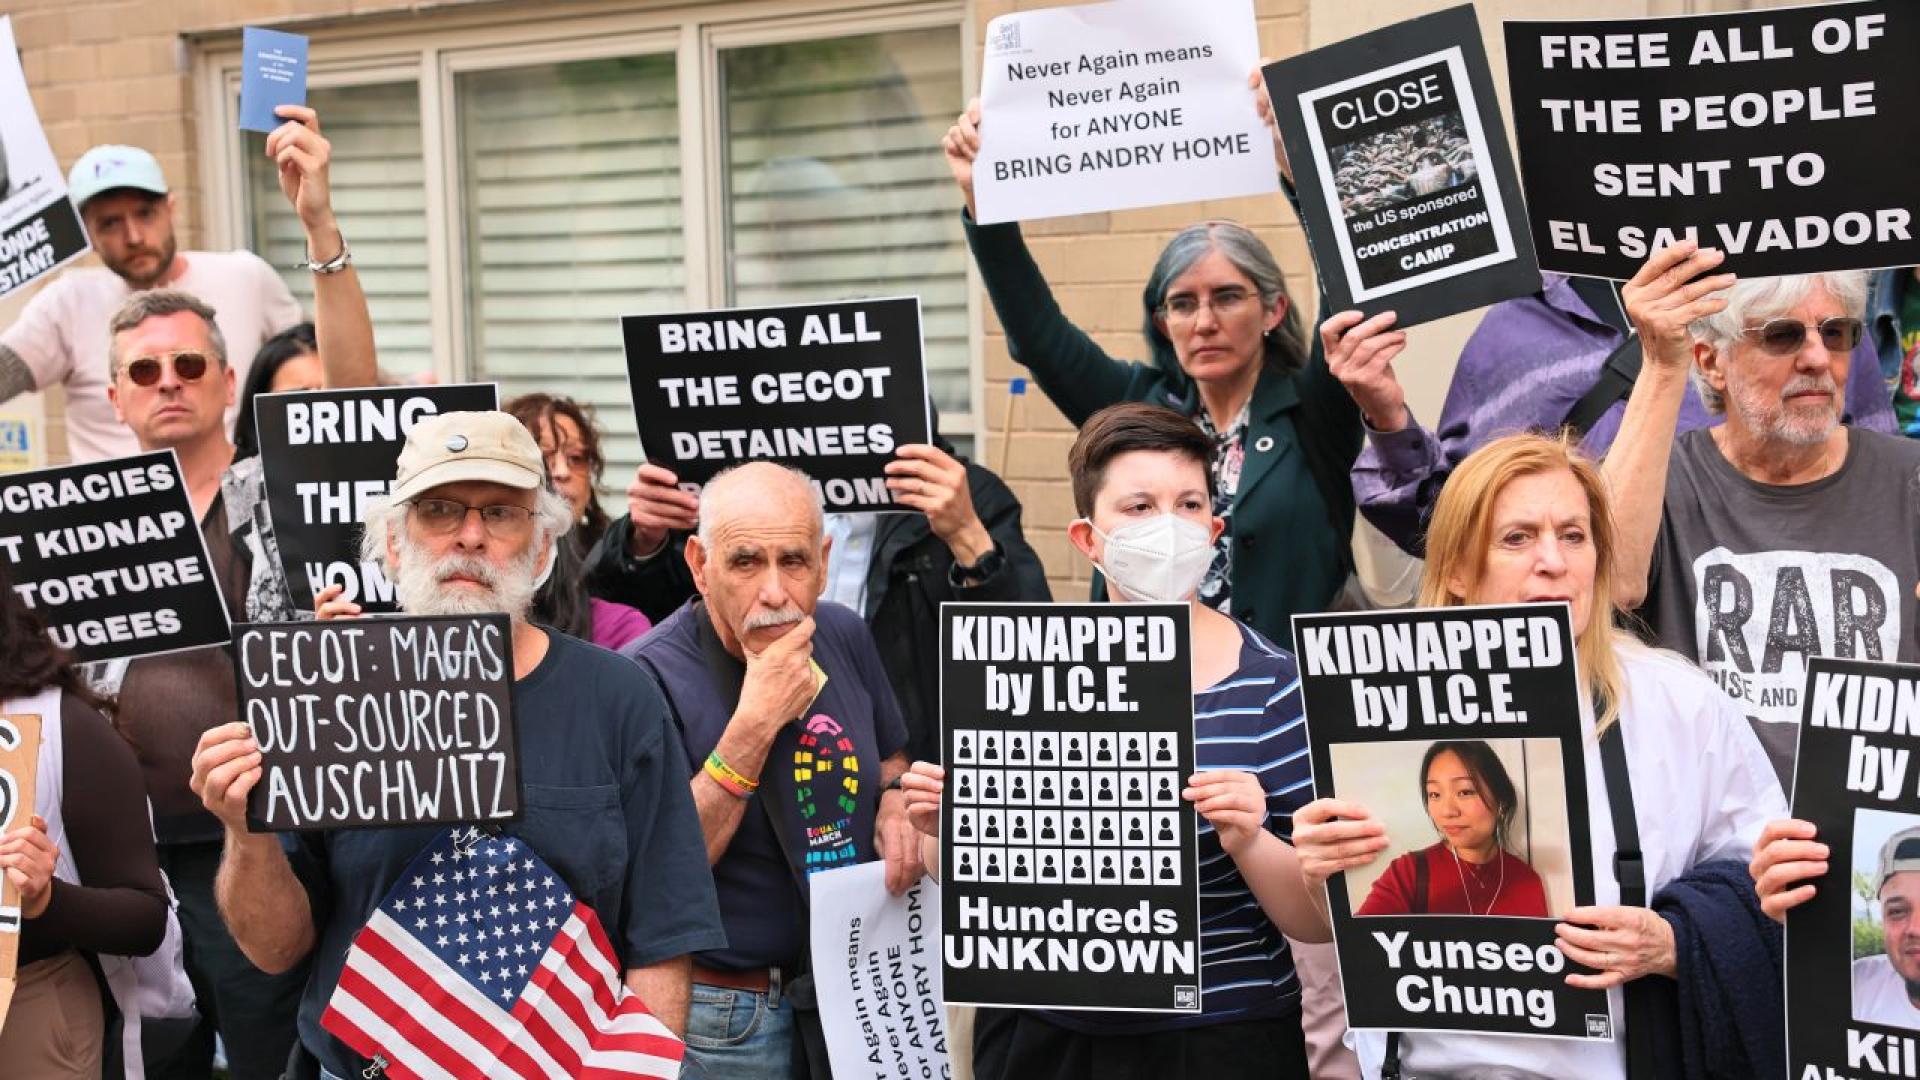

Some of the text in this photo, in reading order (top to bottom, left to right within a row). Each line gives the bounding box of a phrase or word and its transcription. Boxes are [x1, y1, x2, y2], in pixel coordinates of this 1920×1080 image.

[1007, 43, 1213, 82] Never Again means
[1539, 13, 1887, 69] FREE ALL OF
[1048, 76, 1180, 109] Never Again
[1331, 73, 1444, 130] CLOSE
[1541, 81, 1877, 134] THE PEOPLE
[1051, 107, 1184, 141] for ANYONE
[994, 133, 1251, 181] BRING ANDRY HOME
[1593, 152, 1826, 198] SENT TO
[1352, 185, 1478, 235] the US sponsored
[1355, 210, 1490, 260] CONCENTRATION
[1548, 207, 1912, 259] EL SALVADOR
[1400, 242, 1456, 272] CAMP
[659, 311, 882, 354] BRING ALL
[659, 367, 892, 408] THE CECOT
[671, 423, 895, 461] DETAINEES
[296, 480, 397, 524] THE
[809, 478, 899, 506] OM
[35, 511, 186, 559] KIDNAP
[13, 556, 204, 609] TORTURE
[305, 560, 402, 602] HOM
[47, 608, 182, 649] UGEES
[951, 614, 1177, 664] KIDNAPPED
[1703, 563, 1887, 673] RAR
[242, 629, 379, 687] CECOT:
[1301, 616, 1564, 677] KIDNAPPED
[984, 664, 1140, 717] by I.C.E.
[1350, 673, 1529, 732] by I.C.E.
[1760, 687, 1799, 707] AND
[247, 690, 501, 753] OUT-SOURCED
[266, 752, 514, 826] AUSCHWITZ
[1846, 734, 1911, 801] by
[958, 895, 1179, 935] Hundreds
[848, 917, 862, 991] means
[944, 934, 1197, 975] UNKNOWN
[1371, 930, 1566, 975] Yunseo
[867, 950, 892, 1018] Again
[912, 963, 949, 1054] ANDRY
[1395, 974, 1558, 1029] Chung
[855, 997, 883, 1064] Again
[887, 944, 932, 1080] or ANYONE
